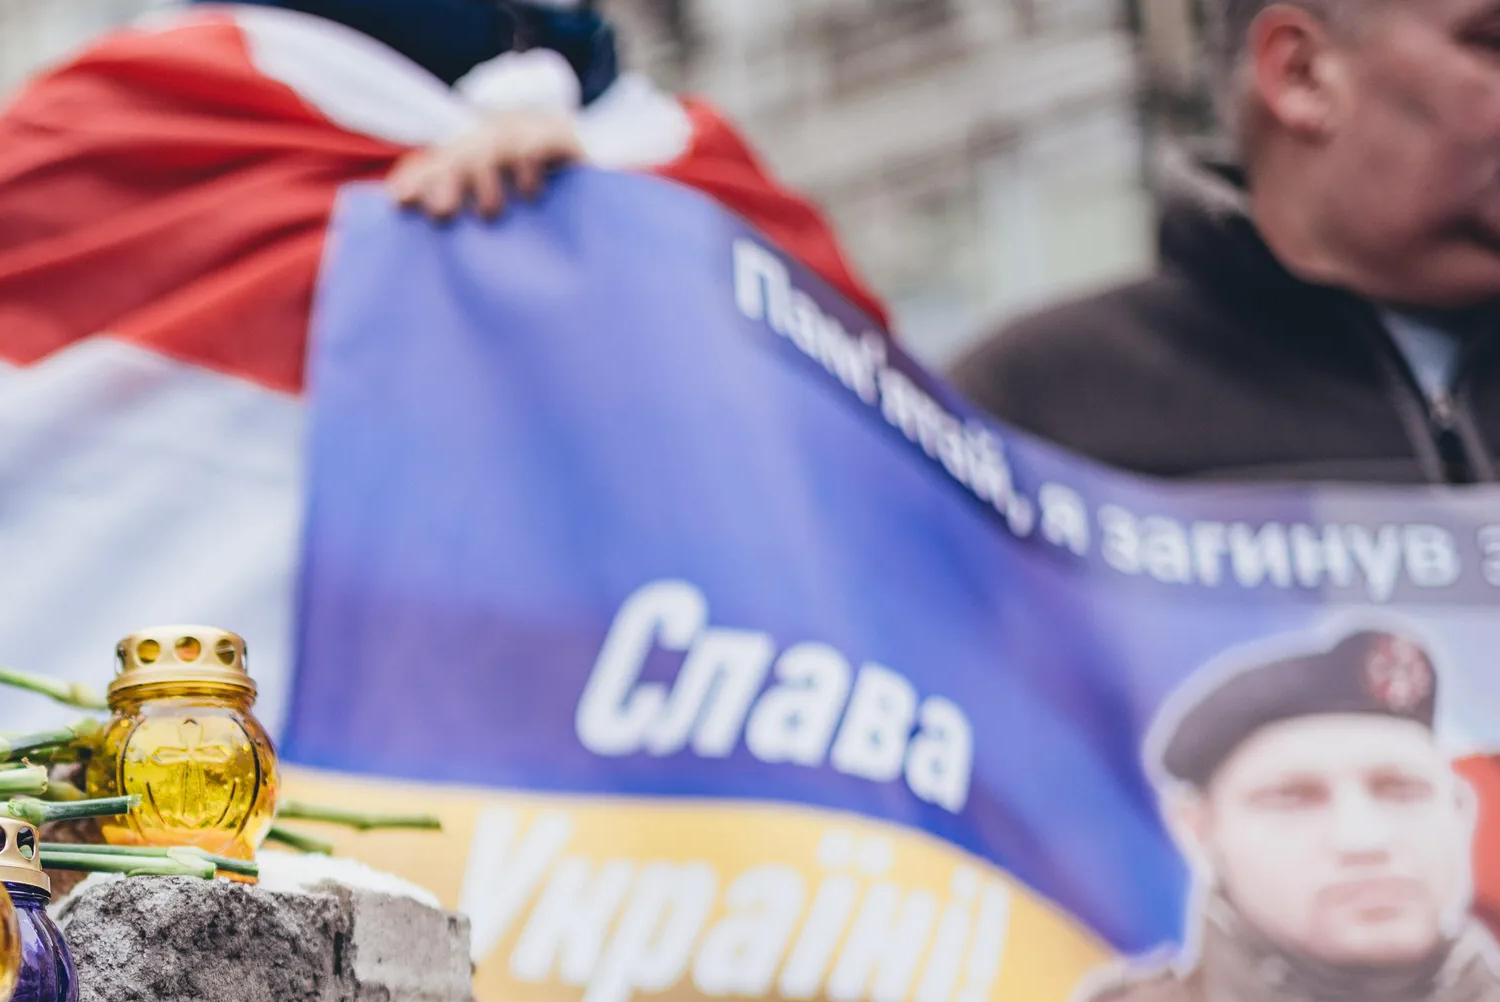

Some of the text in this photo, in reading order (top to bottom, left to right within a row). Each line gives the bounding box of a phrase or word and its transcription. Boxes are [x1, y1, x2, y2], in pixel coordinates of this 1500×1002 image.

[1038, 482, 1088, 556] я
[1097, 503, 1462, 603] загинув
[575, 578, 975, 814] Слава
